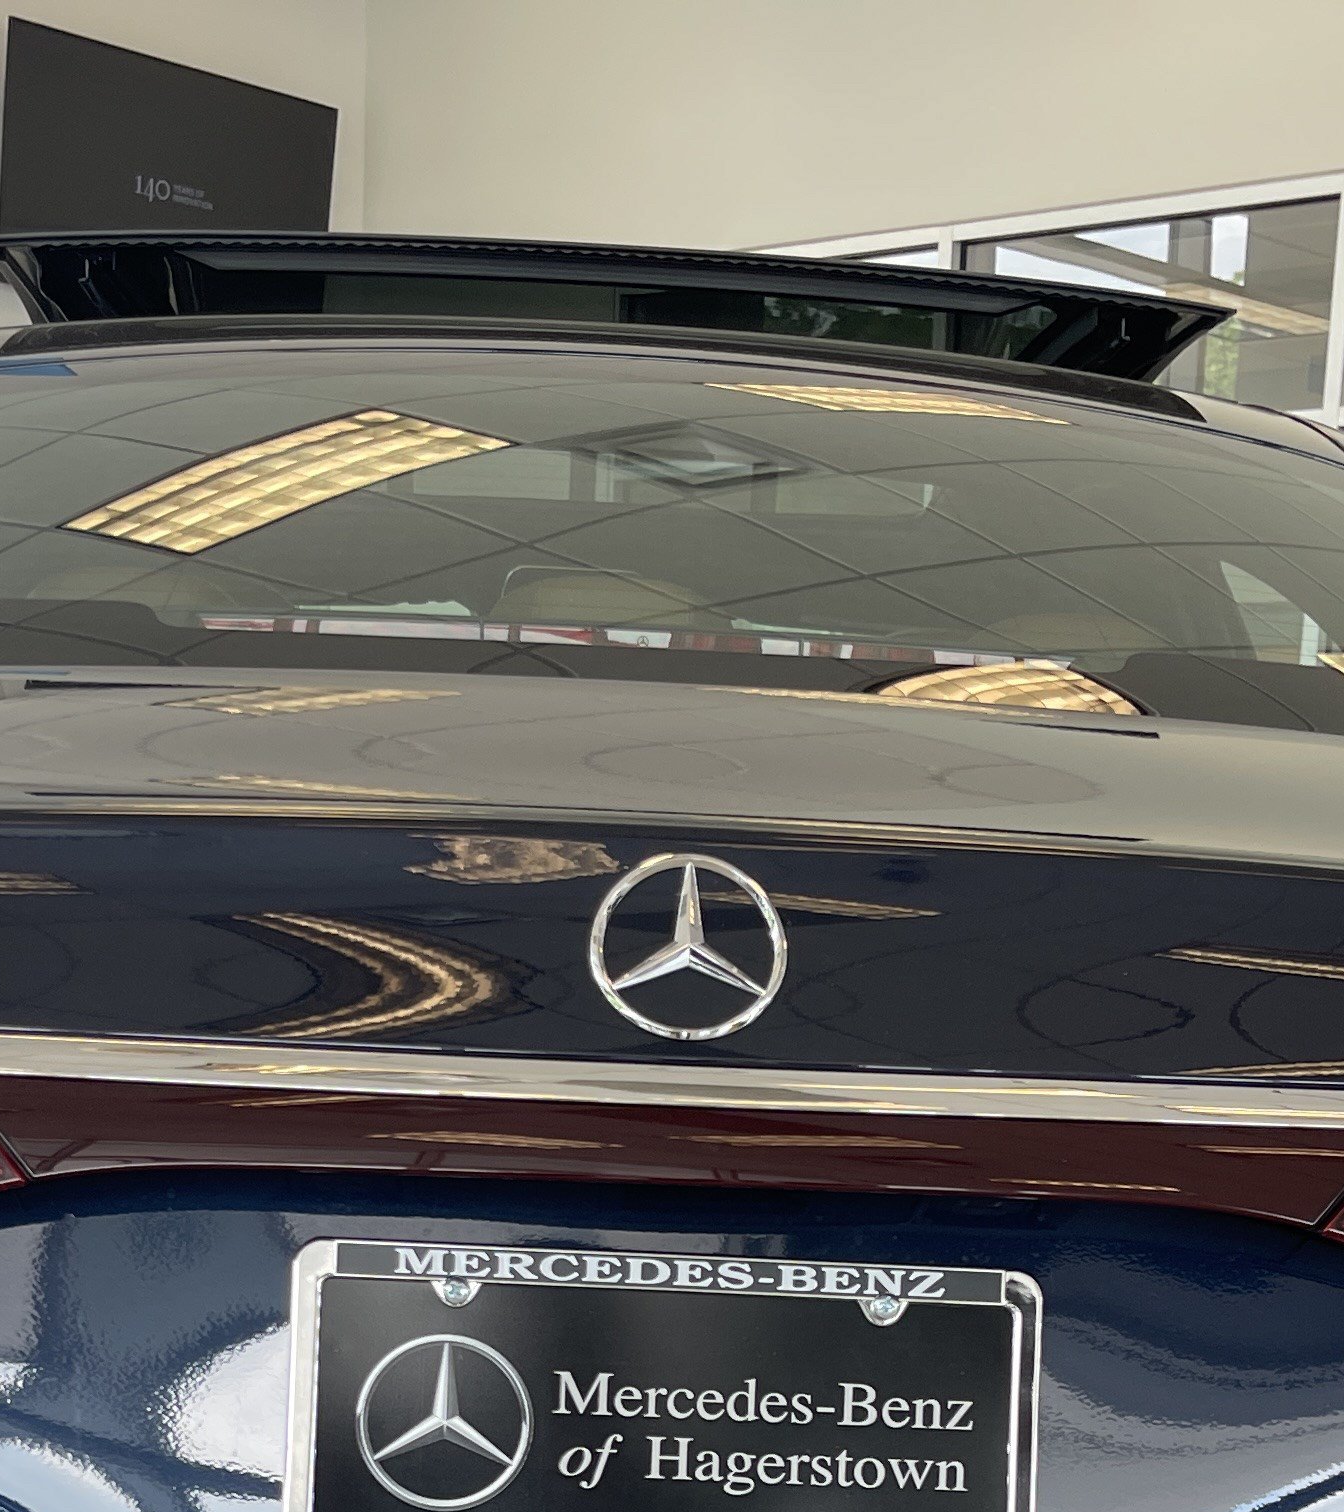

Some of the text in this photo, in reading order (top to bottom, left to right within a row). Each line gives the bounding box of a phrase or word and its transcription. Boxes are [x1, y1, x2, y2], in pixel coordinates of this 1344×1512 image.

[135, 175, 171, 202] 140
[393, 1247, 947, 1298] MERCEDES-BENZ
[551, 1370, 975, 1431] Mercedes-Benz
[557, 1433, 969, 1496] of Hagerstown
